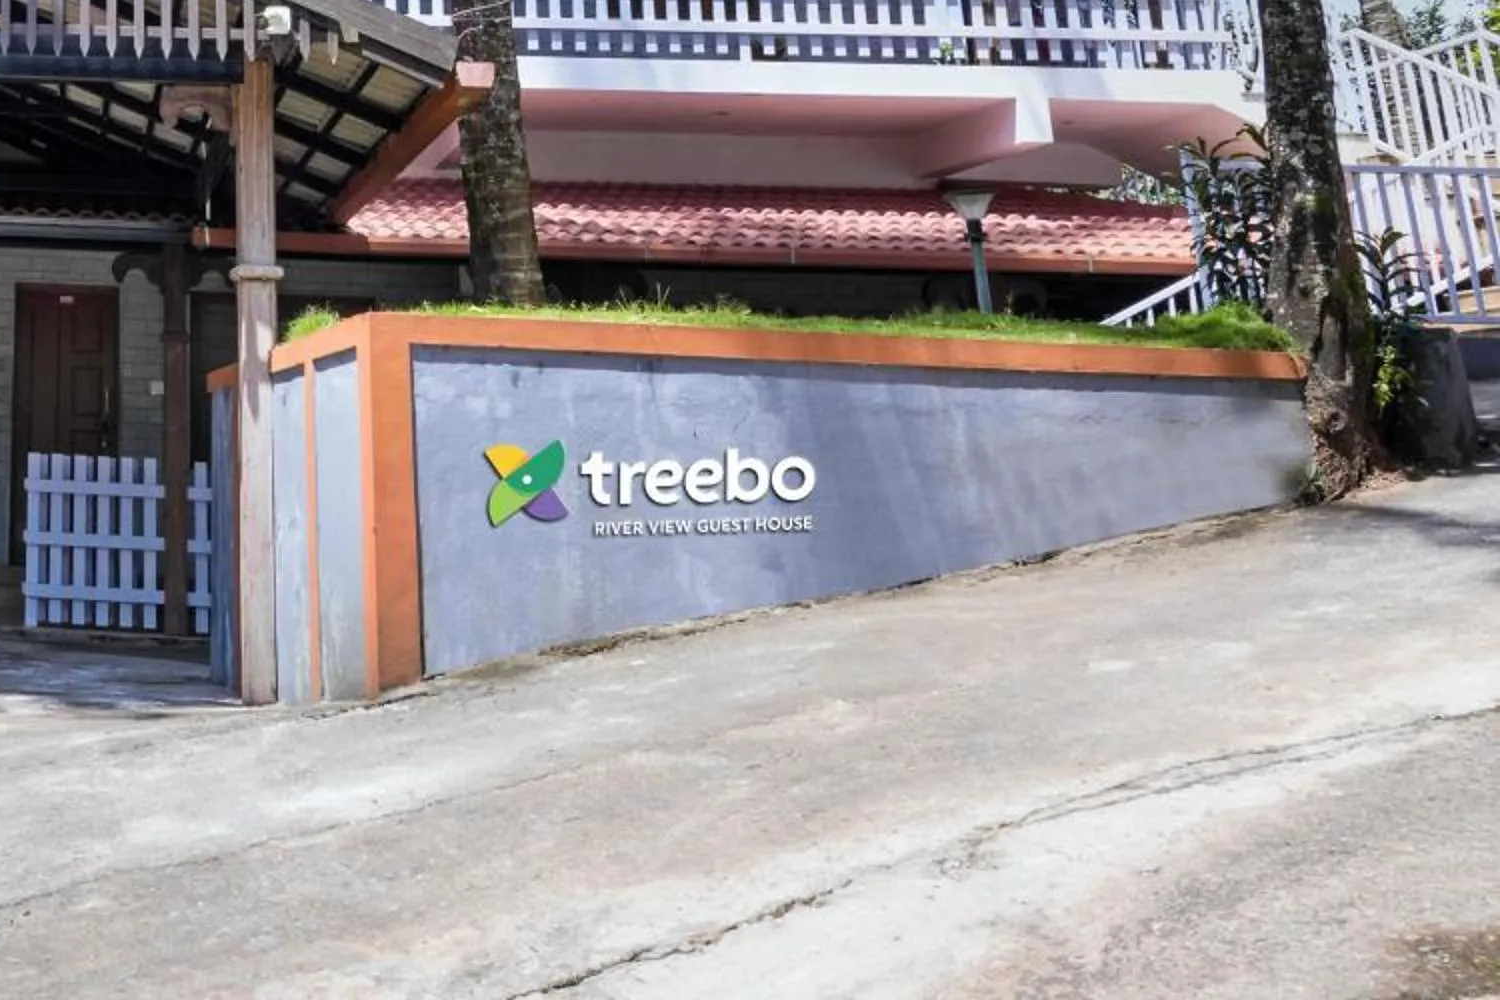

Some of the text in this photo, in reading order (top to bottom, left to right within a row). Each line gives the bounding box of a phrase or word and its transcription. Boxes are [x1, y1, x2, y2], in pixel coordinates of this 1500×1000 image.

[580, 448, 816, 505] treebo
[595, 515, 813, 536] RIVER VIEW GUEST HOUSE
